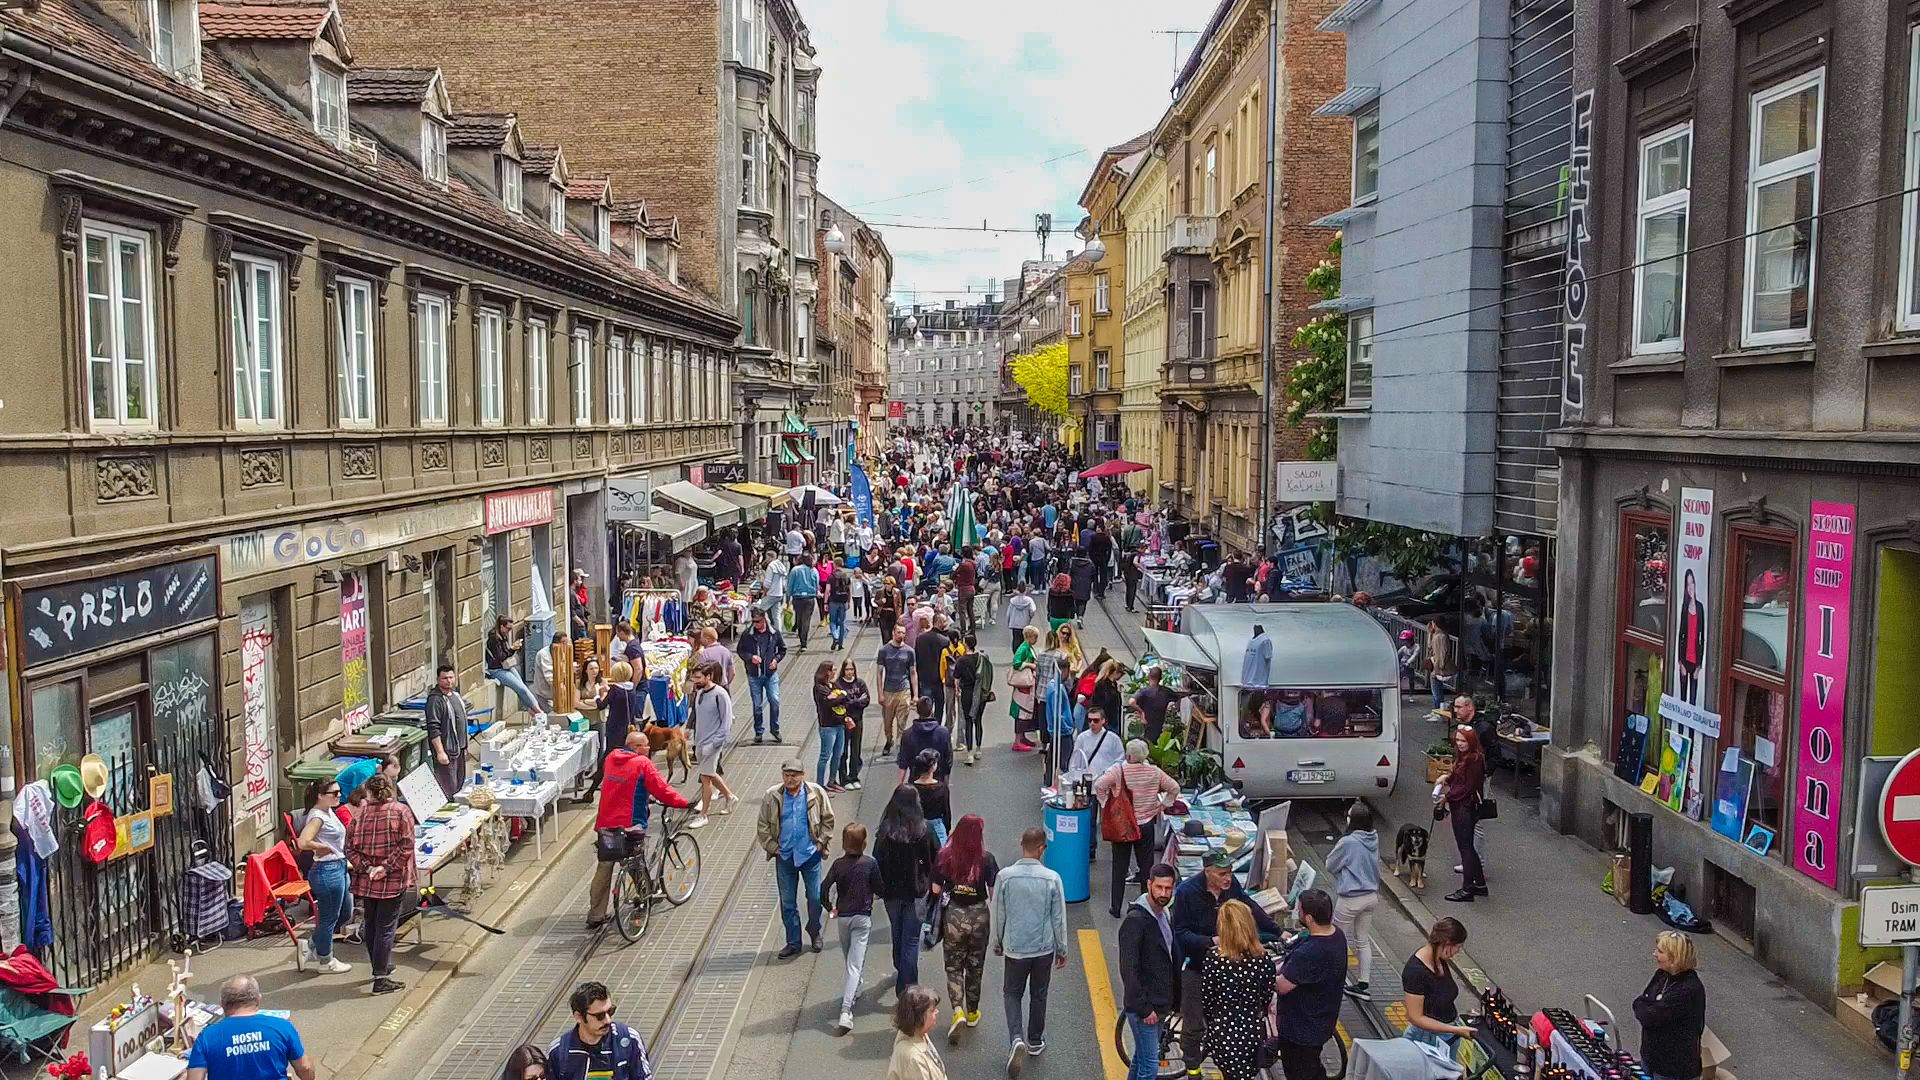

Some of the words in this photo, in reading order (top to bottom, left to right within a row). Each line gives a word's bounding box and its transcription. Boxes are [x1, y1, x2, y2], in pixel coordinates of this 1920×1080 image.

[707, 465, 726, 474] CAFFE
[724, 466, 745, 482] Ag
[1294, 470, 1321, 479] SALON
[1682, 499, 1711, 515] SECOND
[1685, 521, 1705, 537] HAND
[1812, 514, 1852, 534] SECOND
[1683, 544, 1703, 560] SHOP
[1816, 541, 1844, 561] HAND
[1814, 567, 1843, 588] SHOP
[57, 580, 152, 640] PRELO
[1891, 901, 1919, 914] Osim
[1885, 918, 1916, 932] TRAM
[117, 1022, 157, 1063] 100.000
[231, 1031, 262, 1045] HOSNI
[225, 1041, 271, 1057] PONOSNI
